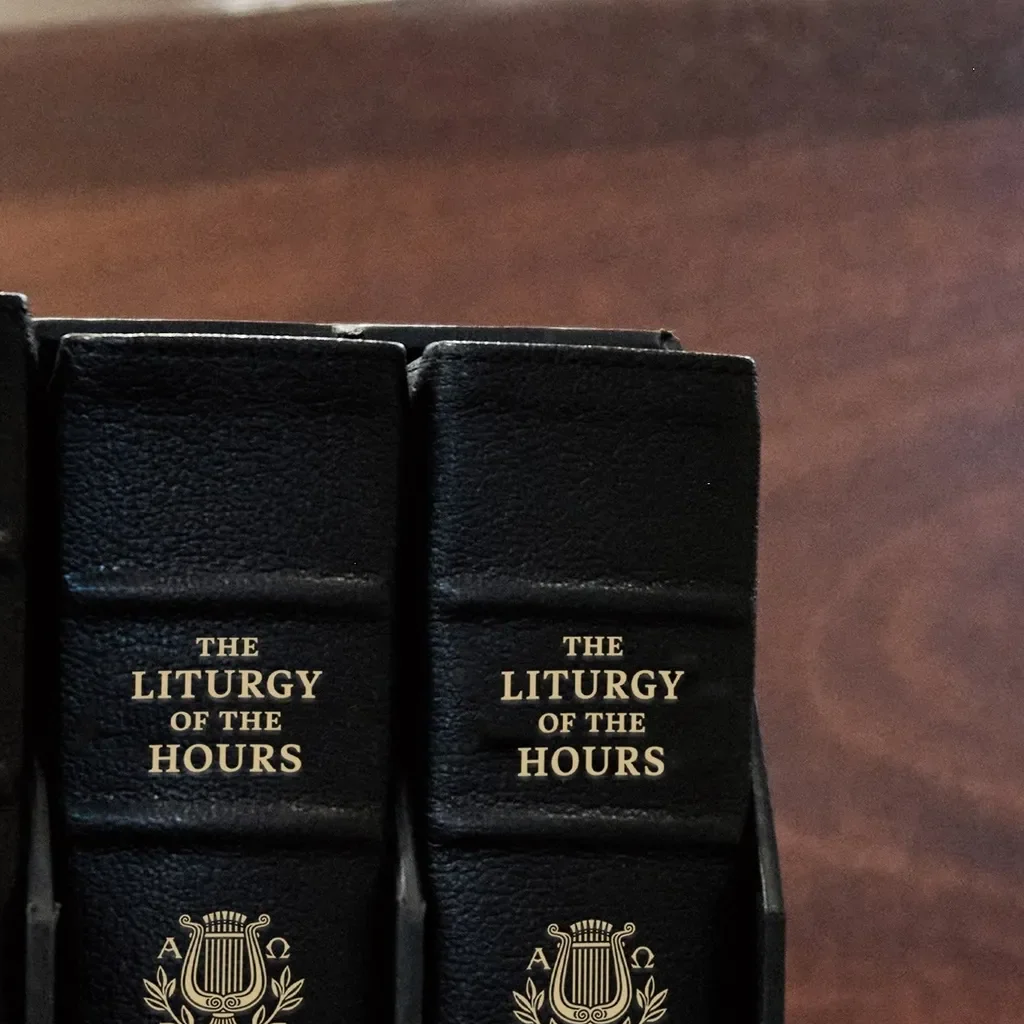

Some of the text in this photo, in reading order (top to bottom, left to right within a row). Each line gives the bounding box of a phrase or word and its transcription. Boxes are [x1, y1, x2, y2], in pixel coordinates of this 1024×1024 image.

[195, 637, 259, 657] THE
[562, 635, 624, 657] THE
[131, 669, 323, 700] LITURGY
[500, 669, 685, 701] LITURGY
[170, 710, 282, 732] OF THE
[538, 712, 646, 734] OF THE
[147, 743, 302, 774] HOURS
[517, 745, 665, 778] HOURS
[265, 936, 291, 959] Ω
[630, 946, 655, 969] Ω
